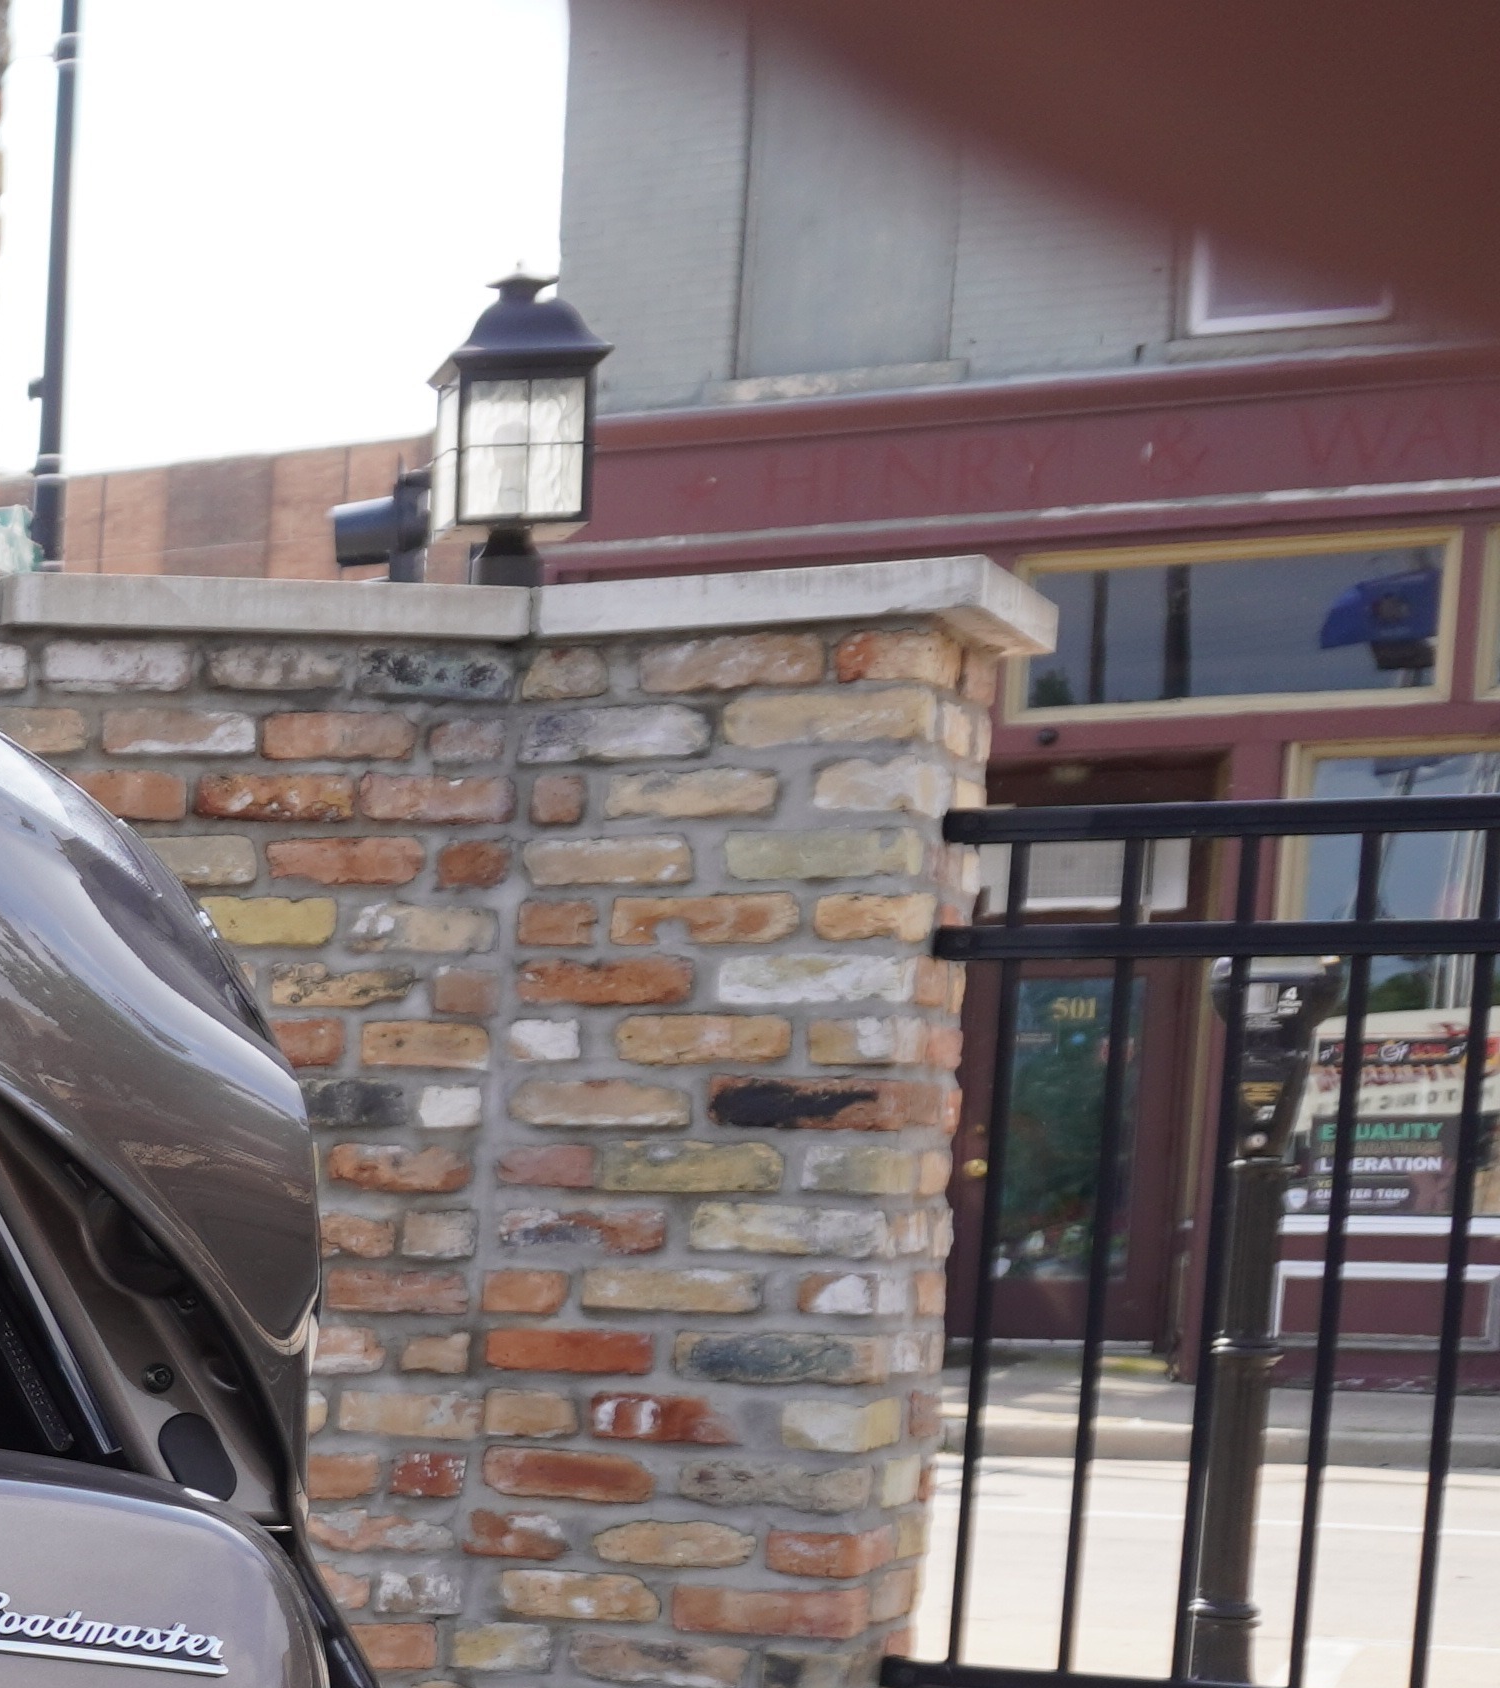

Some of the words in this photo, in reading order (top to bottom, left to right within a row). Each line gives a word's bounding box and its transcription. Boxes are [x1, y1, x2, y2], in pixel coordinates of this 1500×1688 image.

[1051, 996, 1098, 1019] 501
[1319, 1121, 1444, 1141] EUALITY
[1319, 1156, 1443, 1173] LERATION
